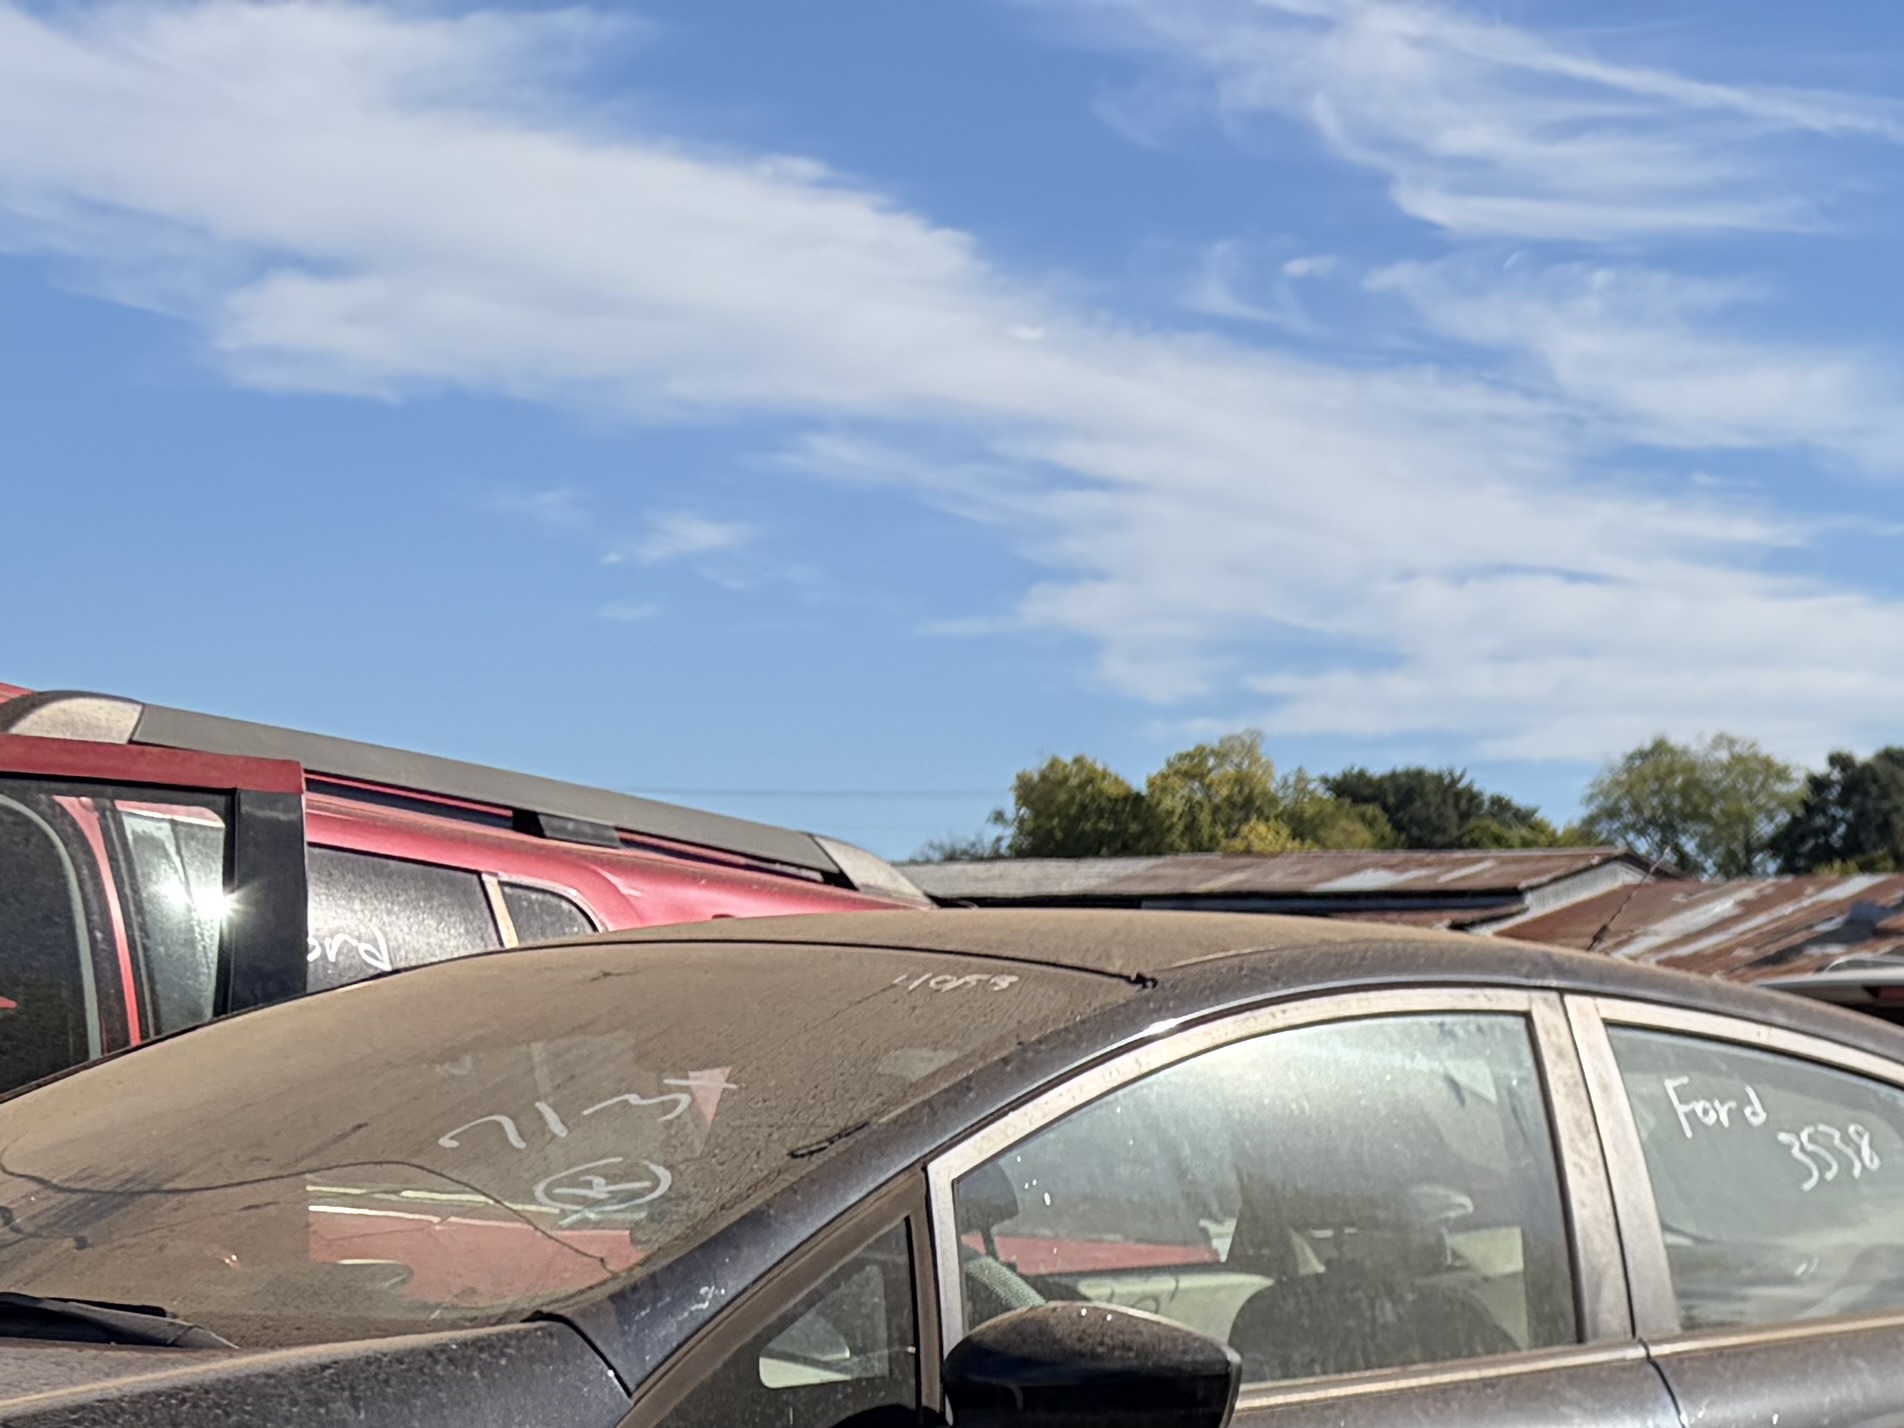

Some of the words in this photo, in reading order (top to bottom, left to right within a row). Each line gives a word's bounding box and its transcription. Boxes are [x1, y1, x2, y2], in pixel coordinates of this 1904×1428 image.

[307, 926, 392, 972] ord
[1664, 1076, 1767, 1139] Ford
[1776, 1123, 1882, 1193] 3538
